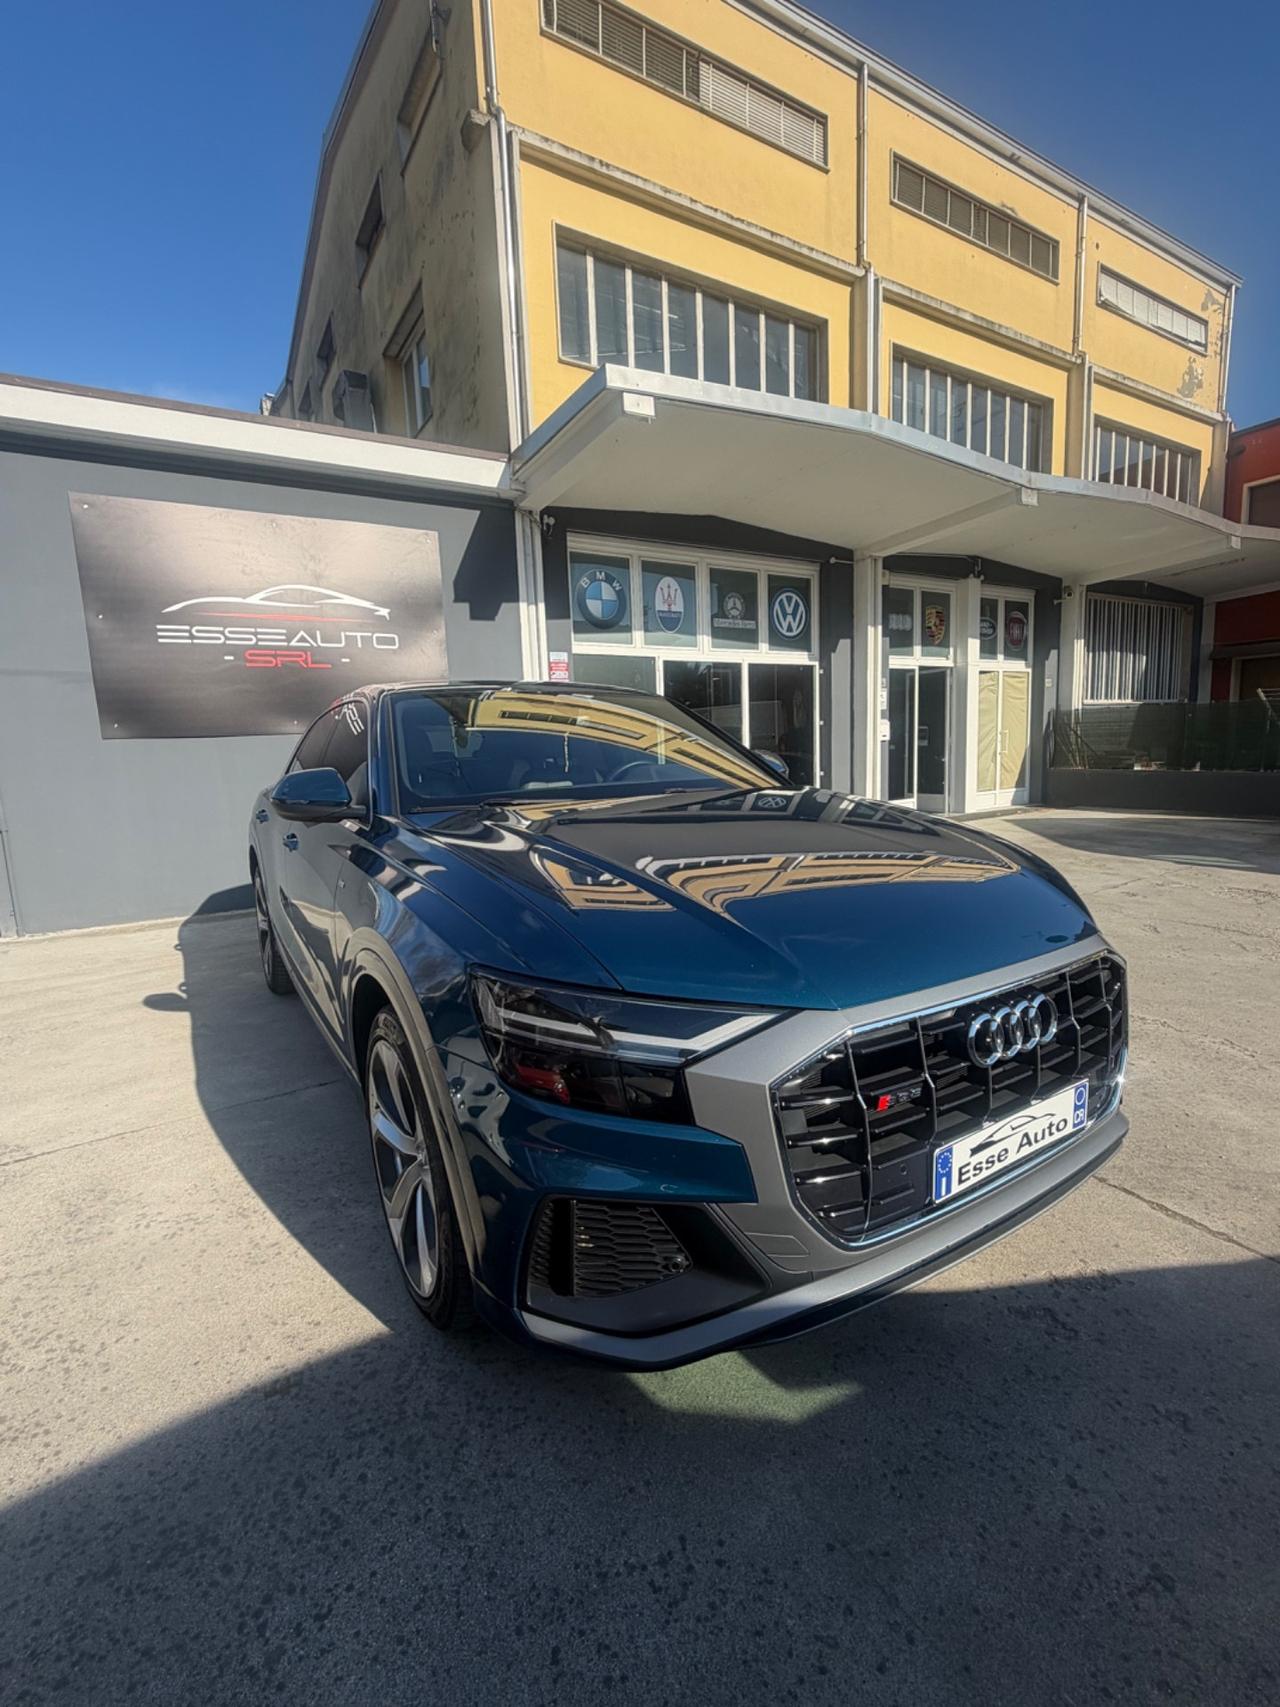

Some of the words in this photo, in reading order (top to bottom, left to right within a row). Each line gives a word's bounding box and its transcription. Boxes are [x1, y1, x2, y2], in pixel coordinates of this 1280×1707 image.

[580, 571, 623, 592] BMW
[156, 625, 399, 649] ESSEAUTO
[957, 1148, 1009, 1186] Esse
[1017, 1118, 1068, 1154] Auto
